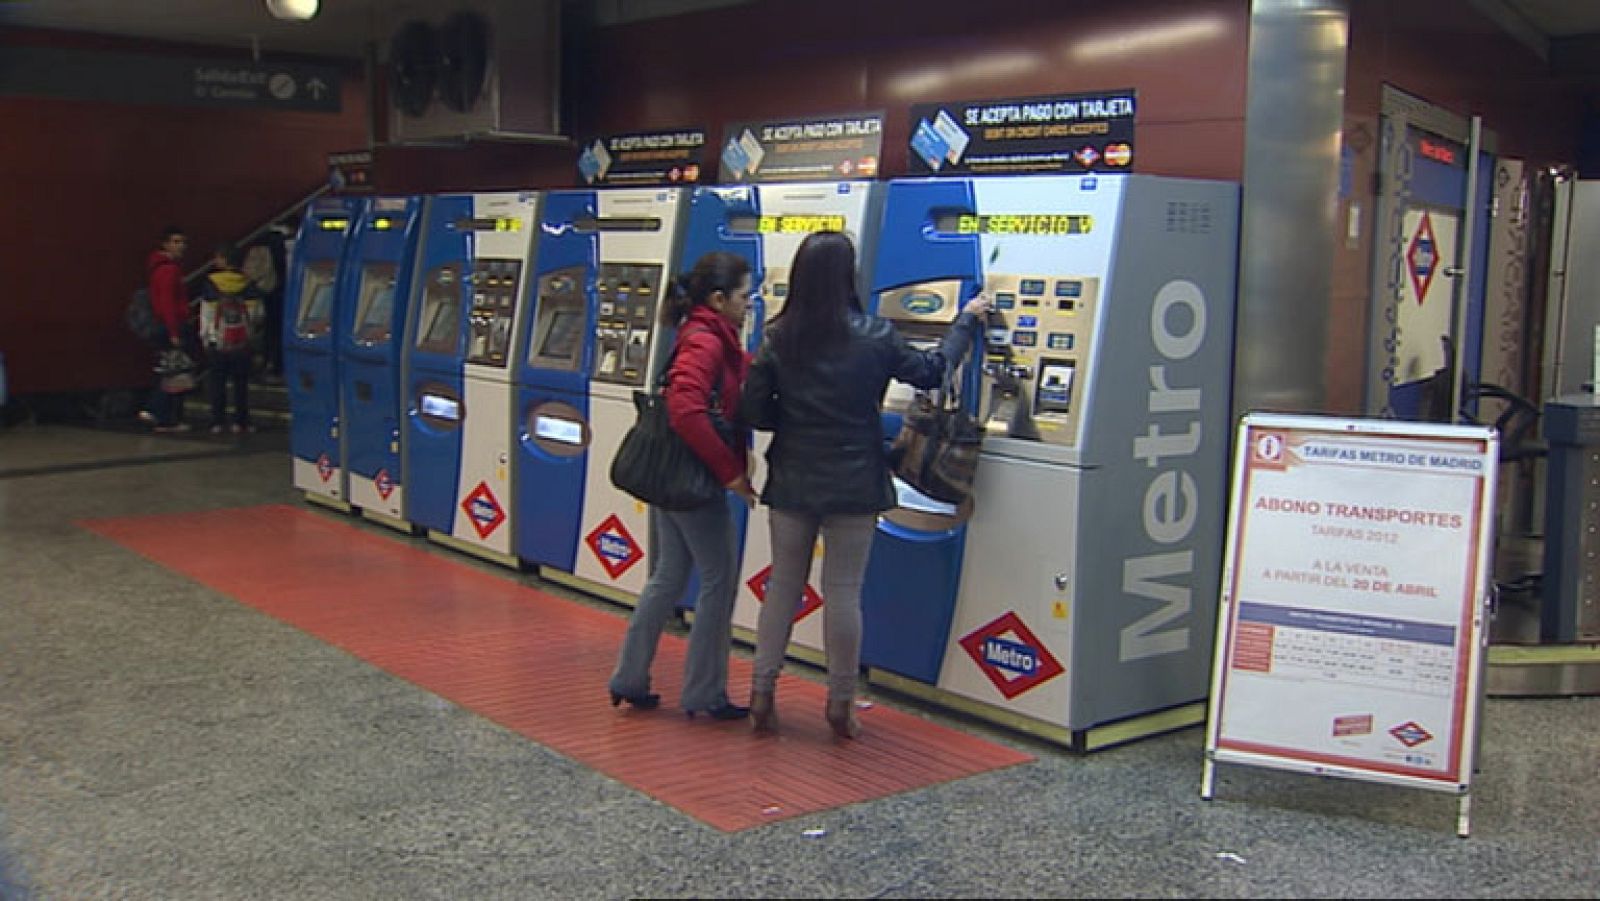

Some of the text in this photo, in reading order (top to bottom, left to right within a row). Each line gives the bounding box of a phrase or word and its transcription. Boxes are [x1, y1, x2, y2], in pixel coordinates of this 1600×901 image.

[965, 98, 1133, 125] SE ACEPTA PAGO CON TARJETA
[958, 215, 979, 234] EN
[988, 215, 1068, 234] SERVICIO
[1119, 279, 1207, 662] Metro
[1304, 445, 1483, 470] TARIFAS METRO DE MADRID
[1256, 496, 1463, 529] ABONO TRANSPORTES
[1311, 525, 1400, 543] TARIFAS 2012
[1313, 560, 1389, 577] A LA VENTA
[1262, 570, 1441, 598] A PARTIR DEL 20 DE ABRIL
[986, 640, 1033, 671] Metro
